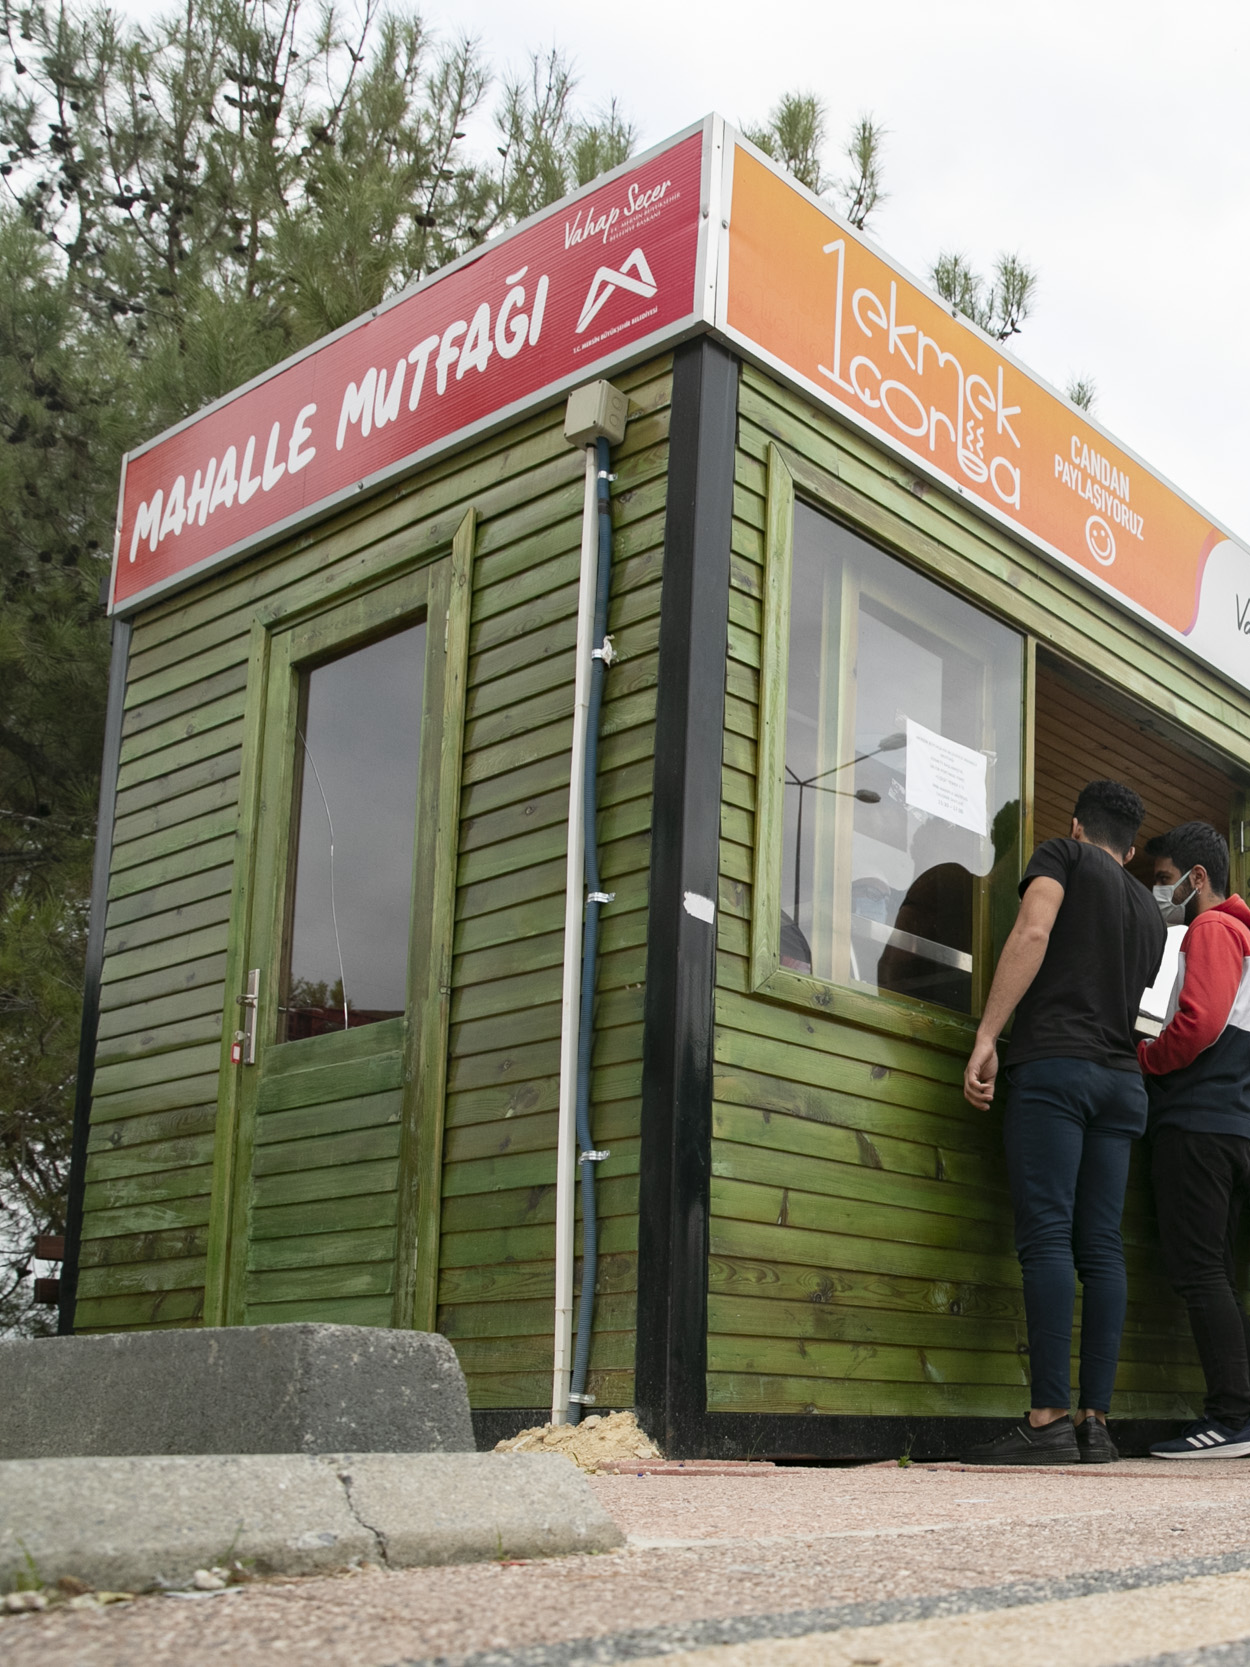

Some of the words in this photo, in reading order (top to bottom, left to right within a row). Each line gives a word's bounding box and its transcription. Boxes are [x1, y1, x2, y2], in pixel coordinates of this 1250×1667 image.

[565, 207, 619, 250] Vahap
[623, 180, 672, 216] Seçer
[852, 280, 1022, 448] ekmek
[129, 403, 317, 563] MAHALLE
[335, 265, 550, 451] MUTFAĞI
[1053, 453, 1145, 541] PAYLAŞIYORUZ
[1070, 434, 1131, 504] CANDAN
